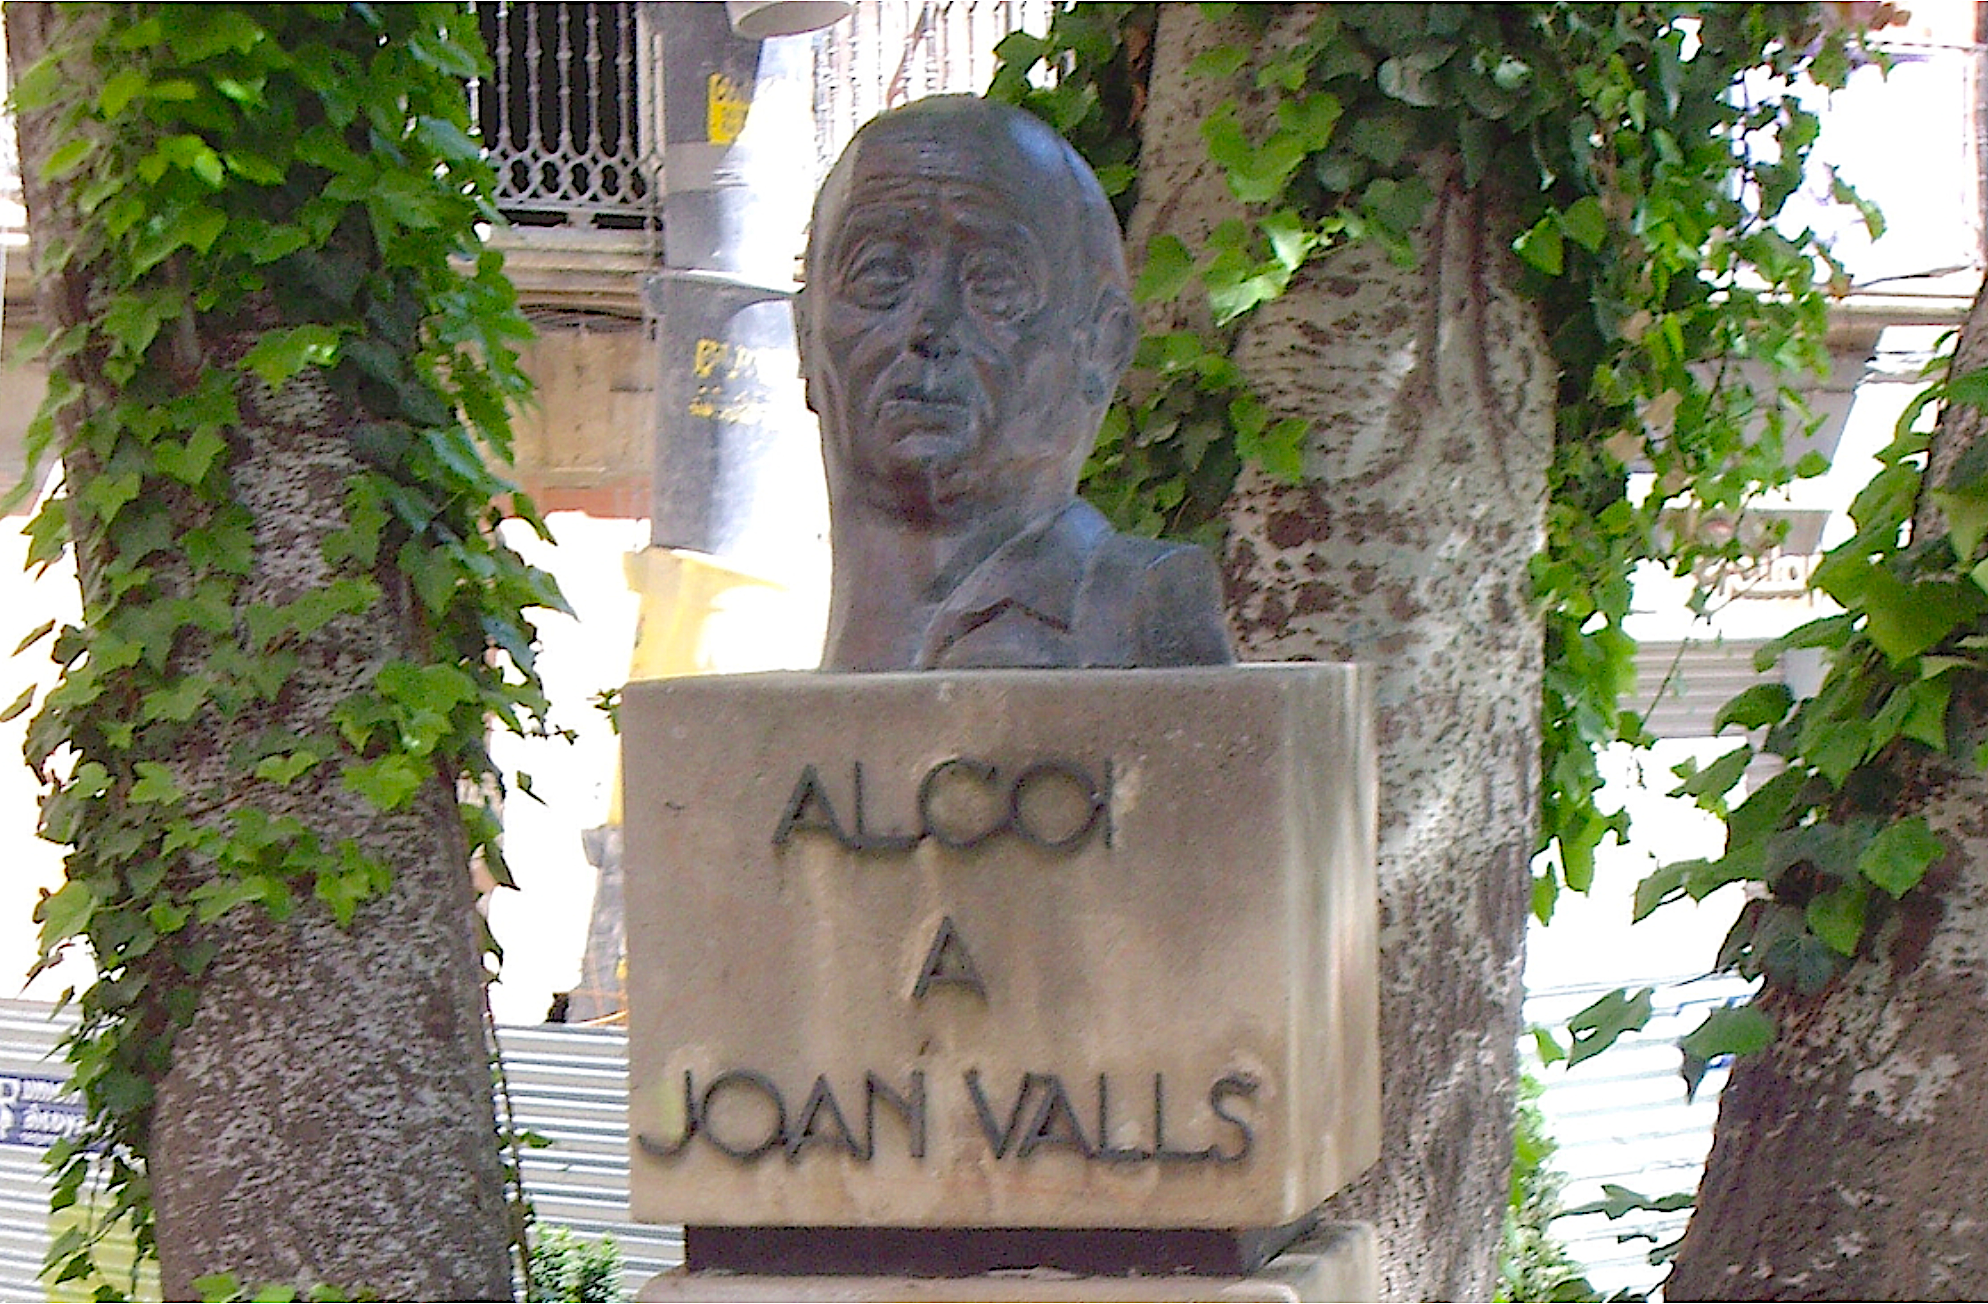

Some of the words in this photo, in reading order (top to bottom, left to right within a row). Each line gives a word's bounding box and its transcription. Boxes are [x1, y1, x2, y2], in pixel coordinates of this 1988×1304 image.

[771, 757, 1113, 852] ALCOI
[911, 914, 990, 1002] A
[638, 1068, 926, 1163] JOAN
[964, 1068, 1261, 1164] VALLS
